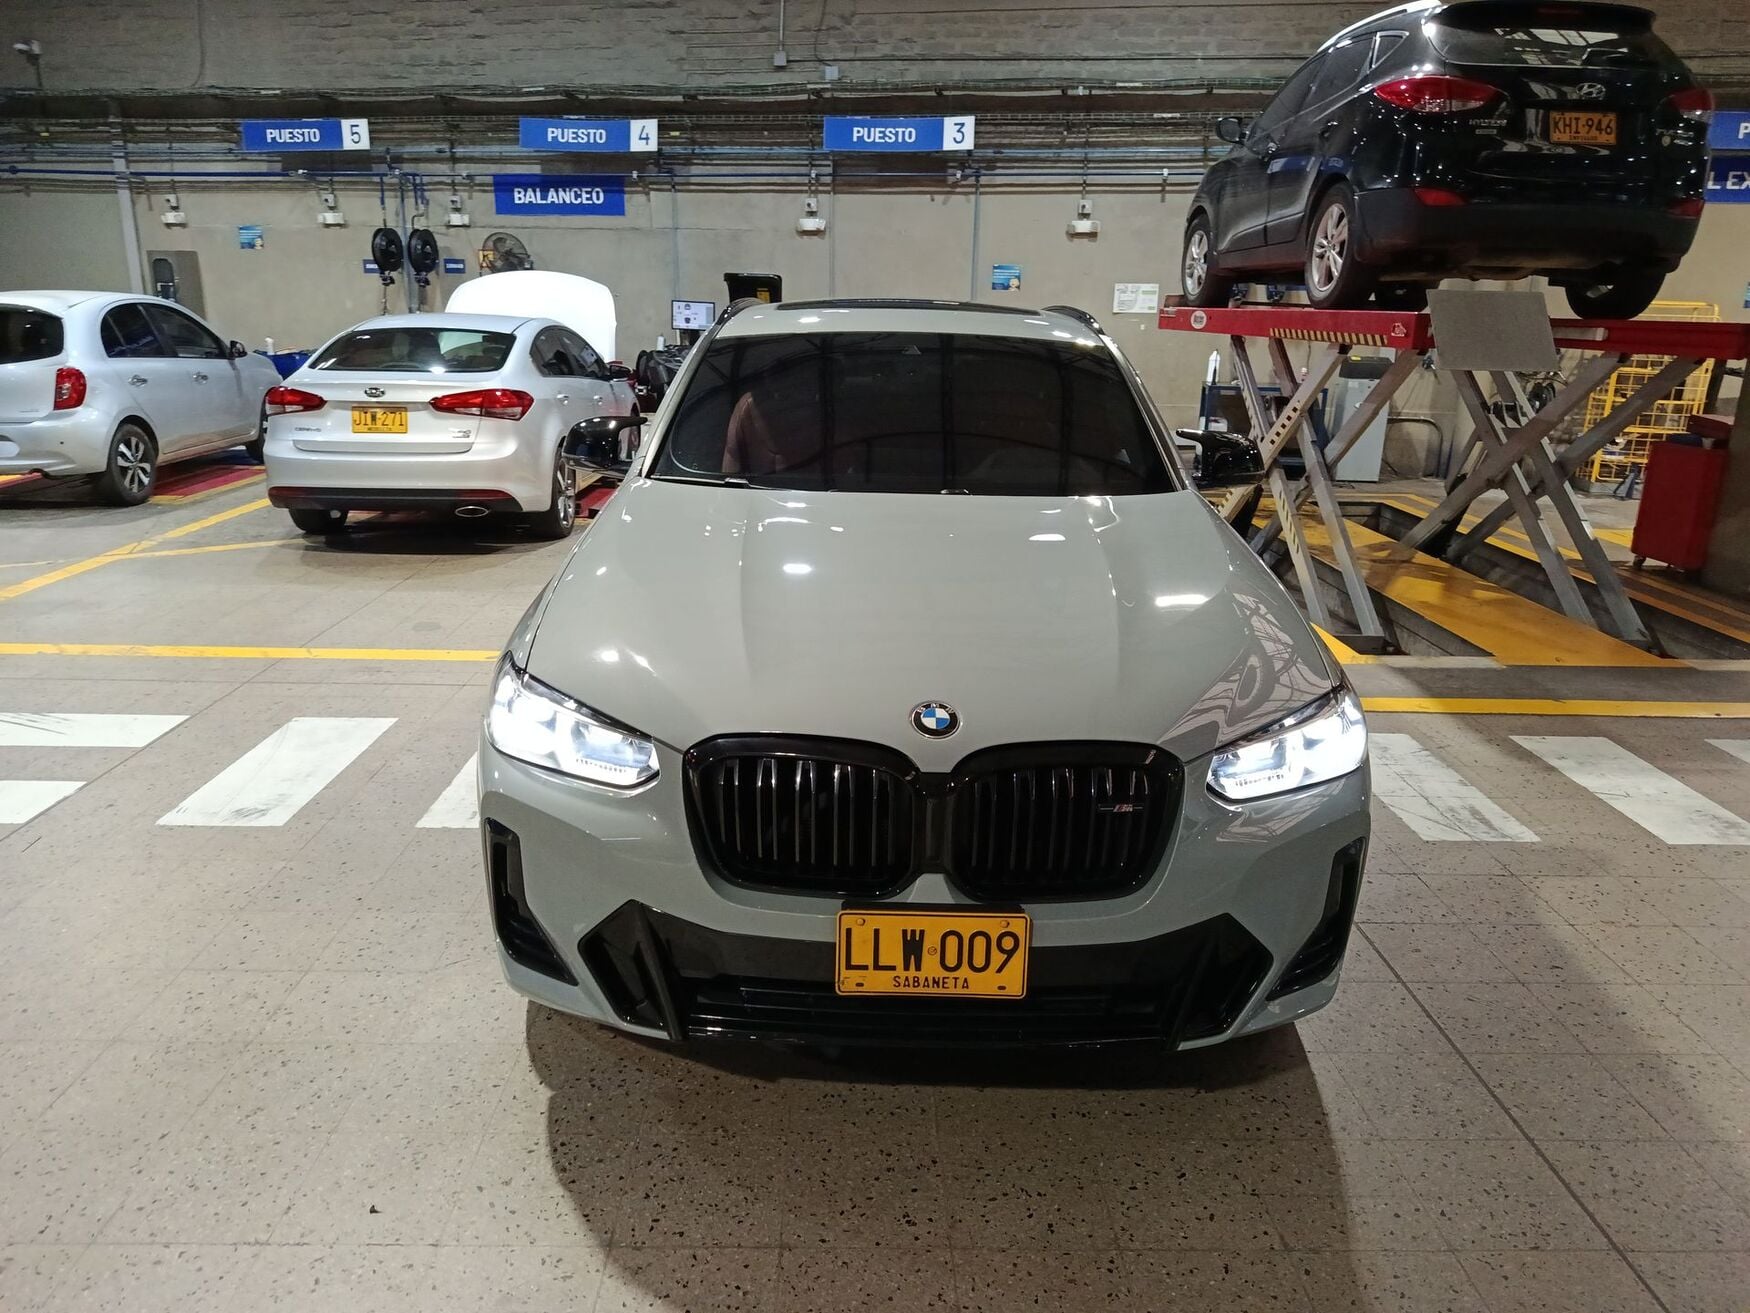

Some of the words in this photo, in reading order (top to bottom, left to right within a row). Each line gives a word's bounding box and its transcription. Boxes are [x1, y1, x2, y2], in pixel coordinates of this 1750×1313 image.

[266, 127, 320, 143] PUESTO
[350, 124, 361, 145] 5
[547, 127, 607, 144] PUESTO
[638, 125, 651, 145] 4
[852, 126, 917, 144] PUESTO
[953, 123, 966, 144] 3
[513, 187, 604, 205] BALANCEO
[893, 975, 969, 990] SABANETA
